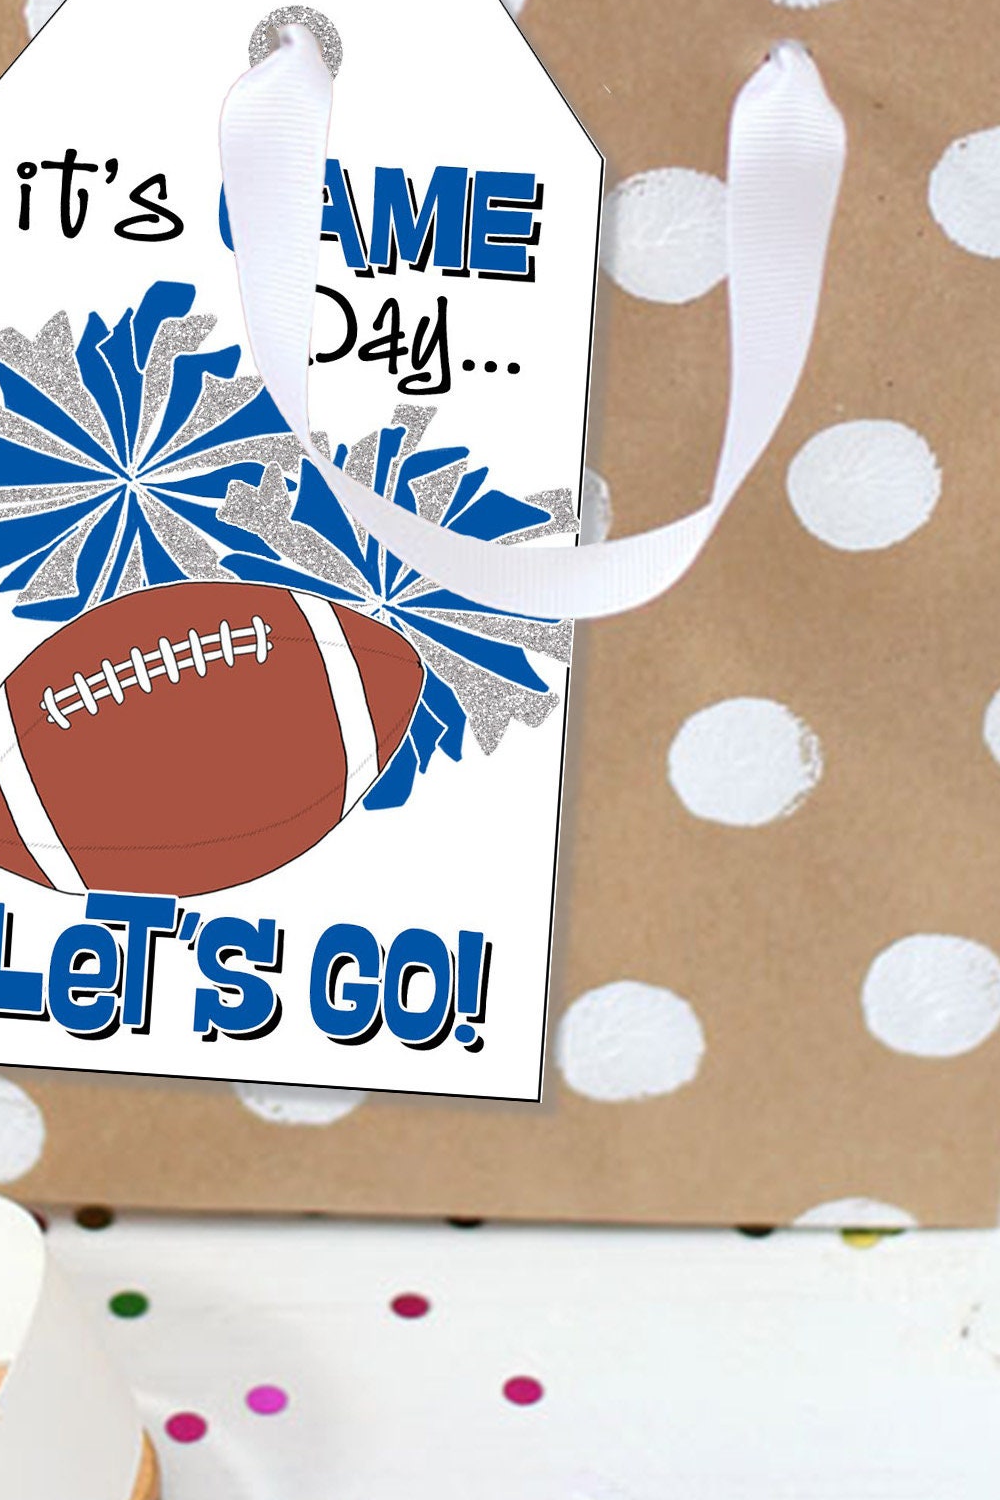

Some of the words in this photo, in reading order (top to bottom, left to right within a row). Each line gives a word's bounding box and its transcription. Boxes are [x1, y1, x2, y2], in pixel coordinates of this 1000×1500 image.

[17, 149, 184, 241] it's
[218, 158, 545, 283] AME
[309, 923, 493, 1054] GO!
